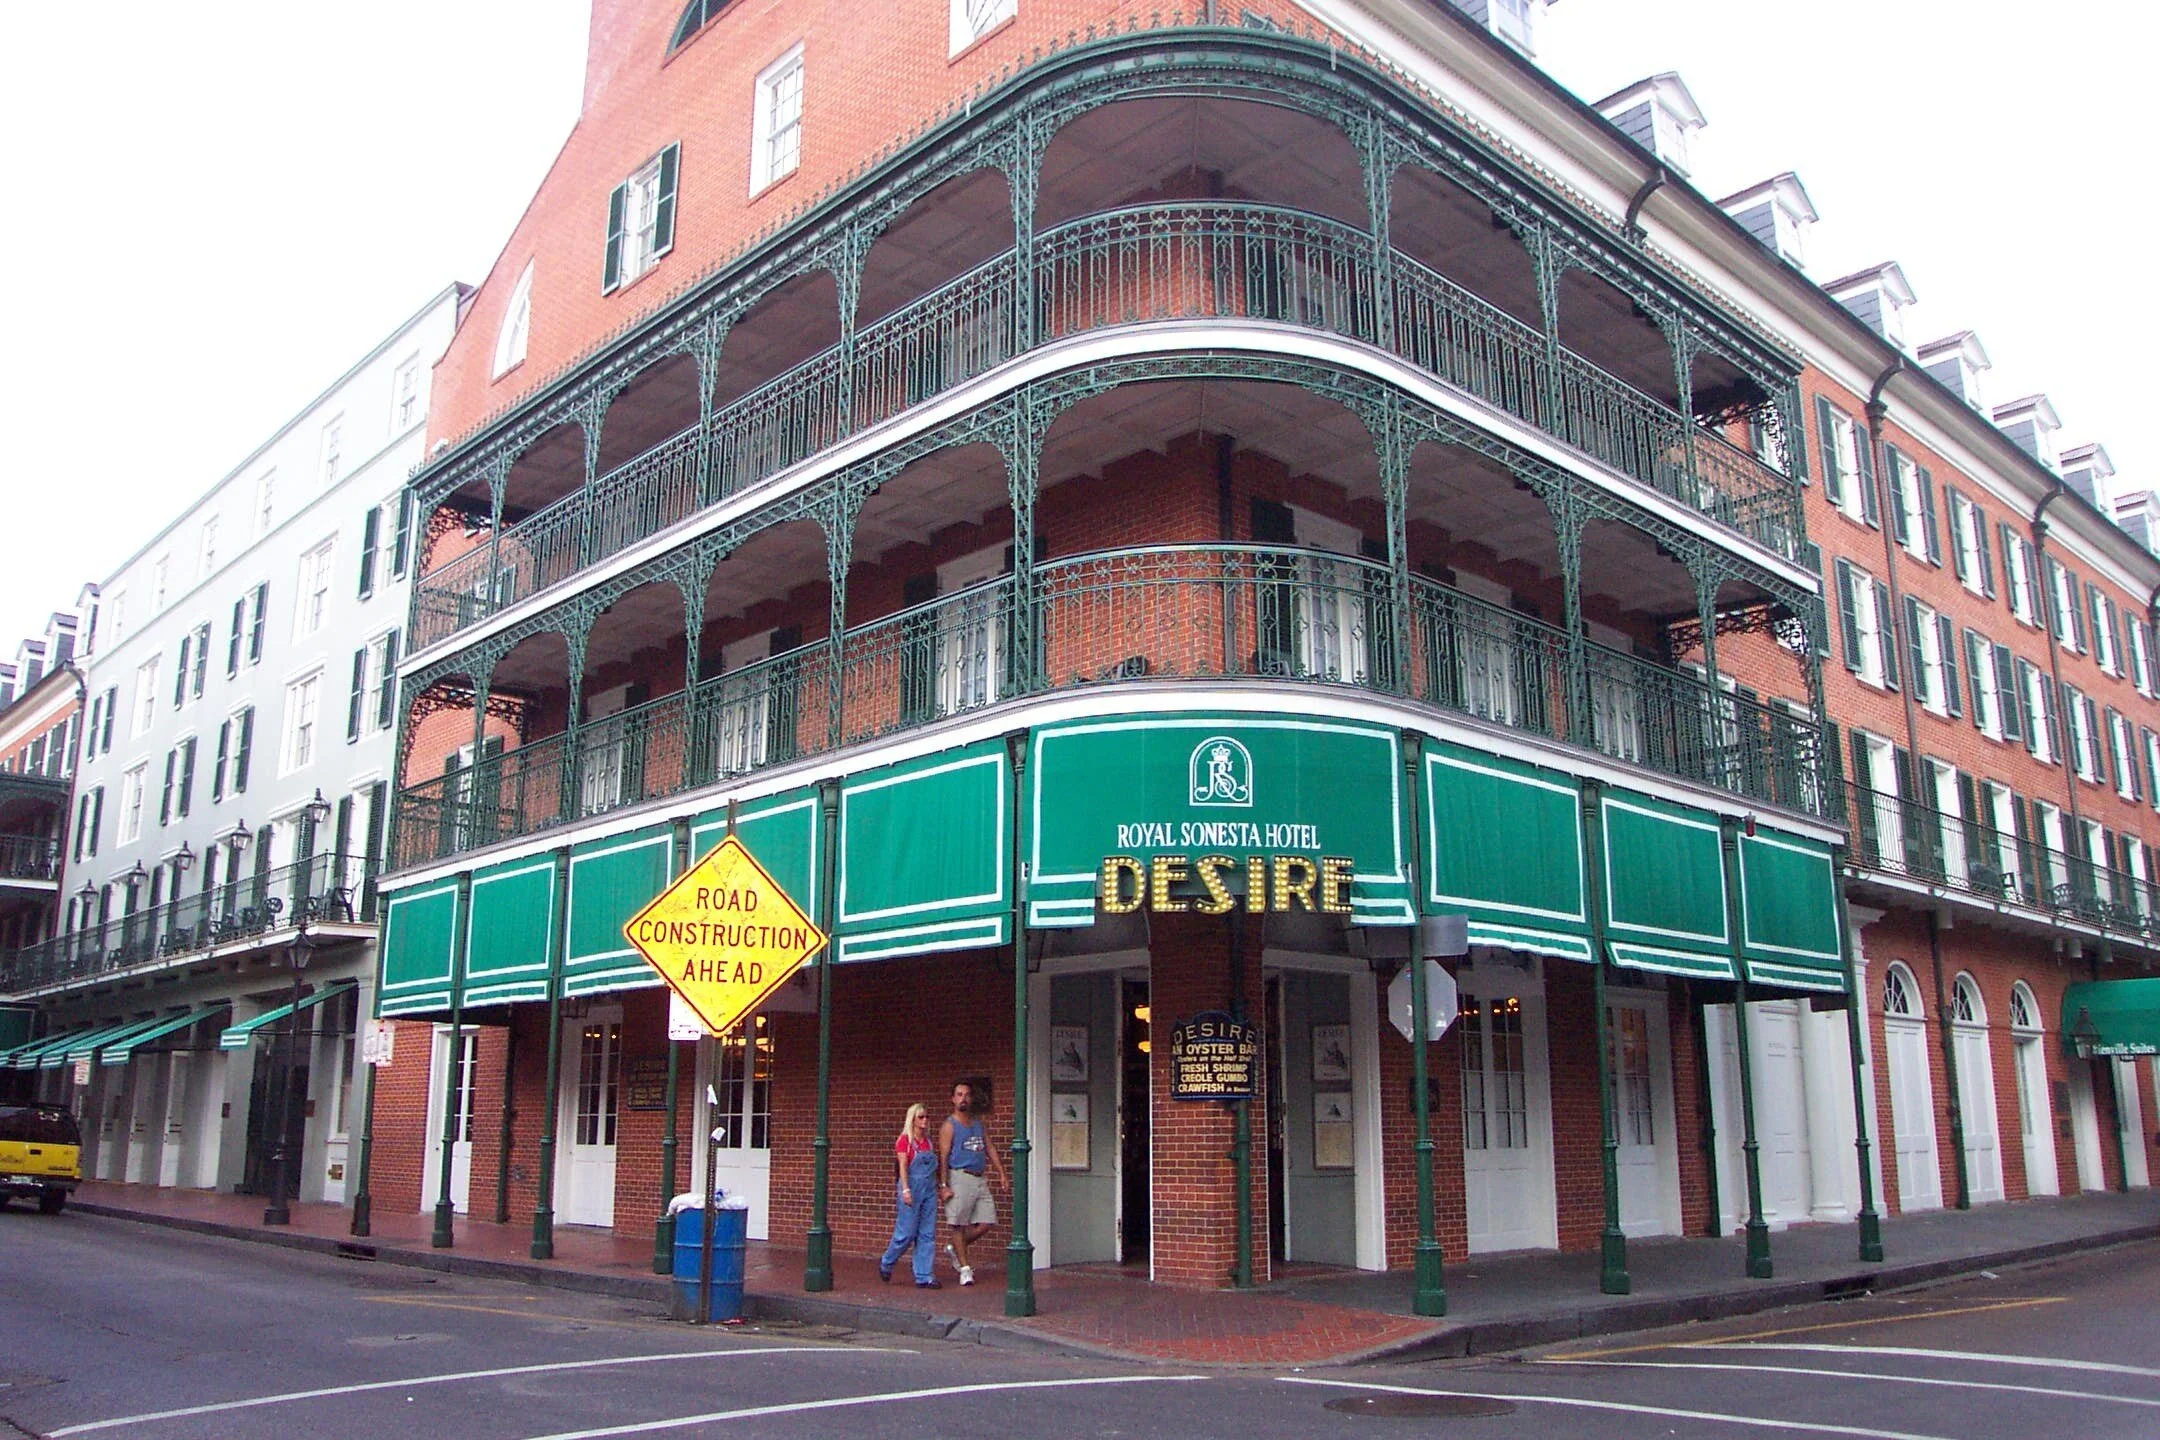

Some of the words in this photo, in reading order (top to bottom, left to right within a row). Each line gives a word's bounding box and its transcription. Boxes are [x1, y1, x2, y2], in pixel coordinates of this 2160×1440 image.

[1117, 823, 1176, 848] ROYAL
[1181, 822, 1261, 847] SONESTA
[1265, 823, 1321, 849] HOTEL
[1103, 854, 1354, 915] DESIRE
[696, 887, 758, 912] ROAD
[639, 920, 807, 950] CONSTRUCTION
[683, 959, 763, 984] AHEAD
[1173, 1022, 1256, 1044] DESIRE
[1186, 1043, 1234, 1054] OYSTER
[1239, 1044, 1258, 1055] BAR
[1180, 1063, 1209, 1073] FRESH
[1213, 1063, 1248, 1073] SHRIMP
[1181, 1073, 1213, 1083] CREOLE
[1216, 1073, 1248, 1083] GUMBO
[1178, 1083, 1225, 1093] CRAWFISH
